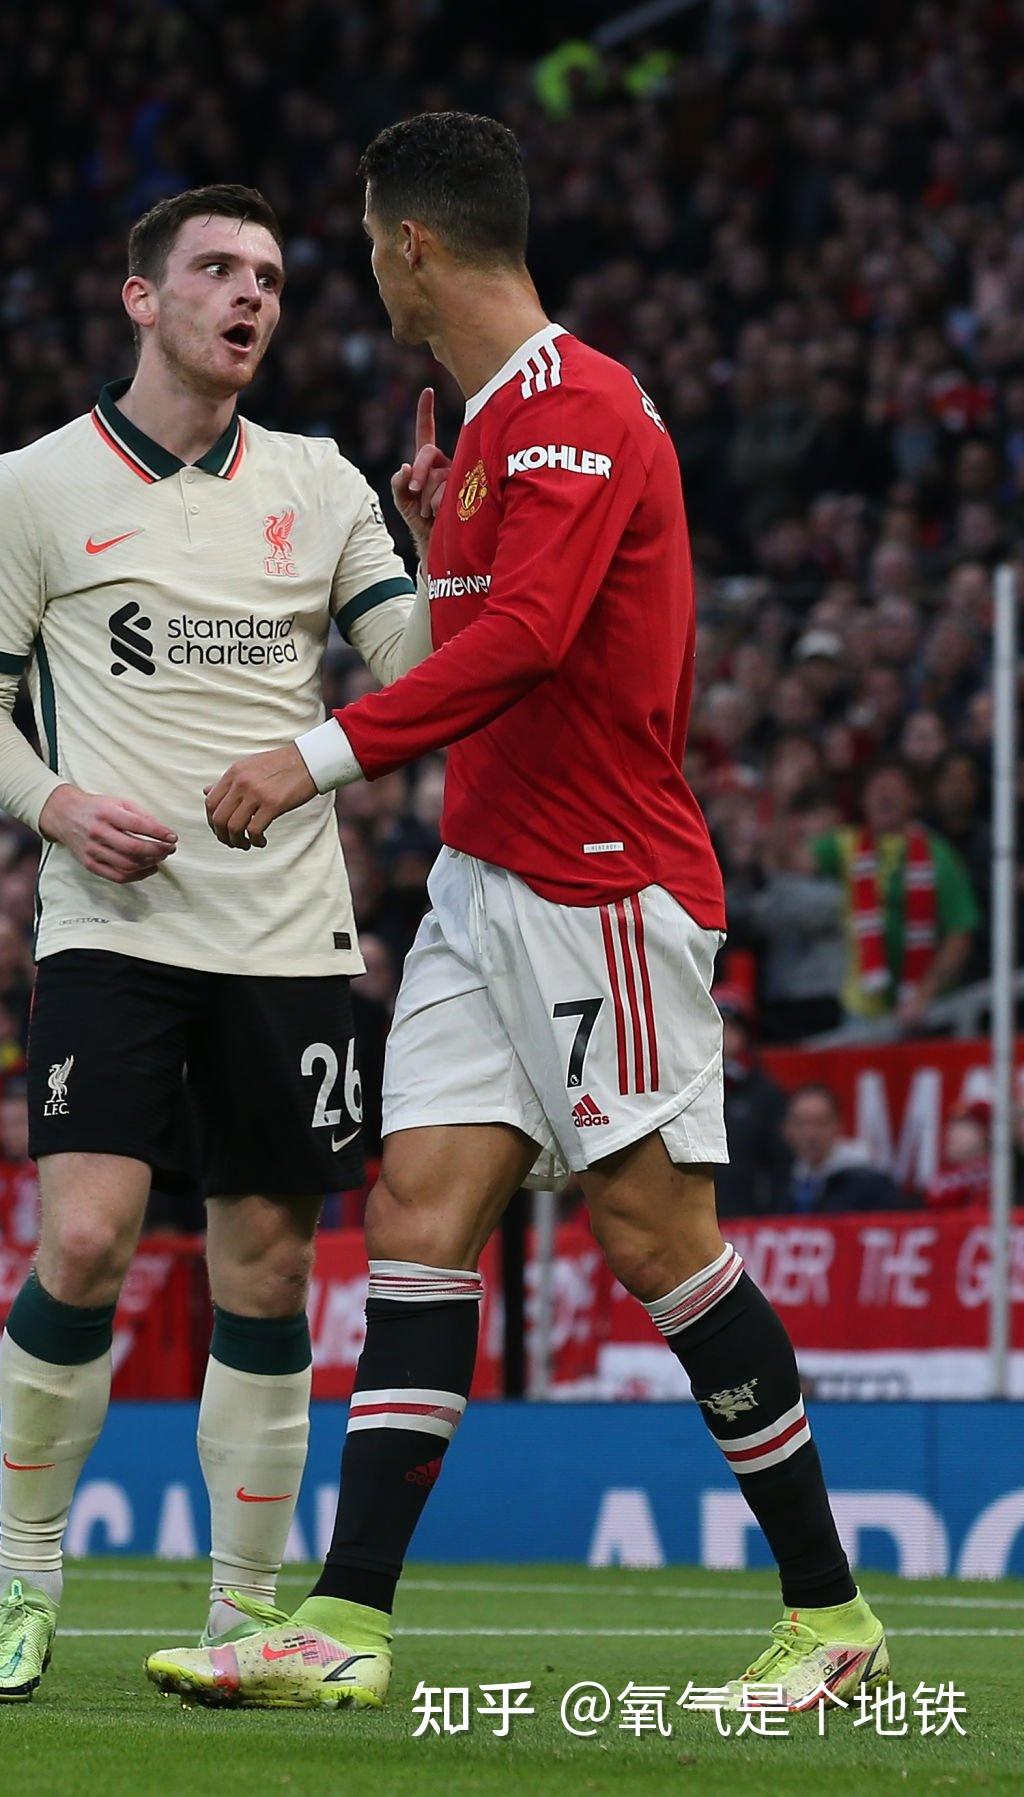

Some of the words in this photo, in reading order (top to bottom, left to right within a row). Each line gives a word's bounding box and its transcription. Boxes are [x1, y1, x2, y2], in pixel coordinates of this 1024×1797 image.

[507, 445, 612, 479] KOHLER
[167, 615, 295, 639] standard
[167, 639, 299, 666] chartered
[553, 997, 604, 1088] 7
[301, 1038, 363, 1128] 26
[859, 1227, 938, 1307] THE
